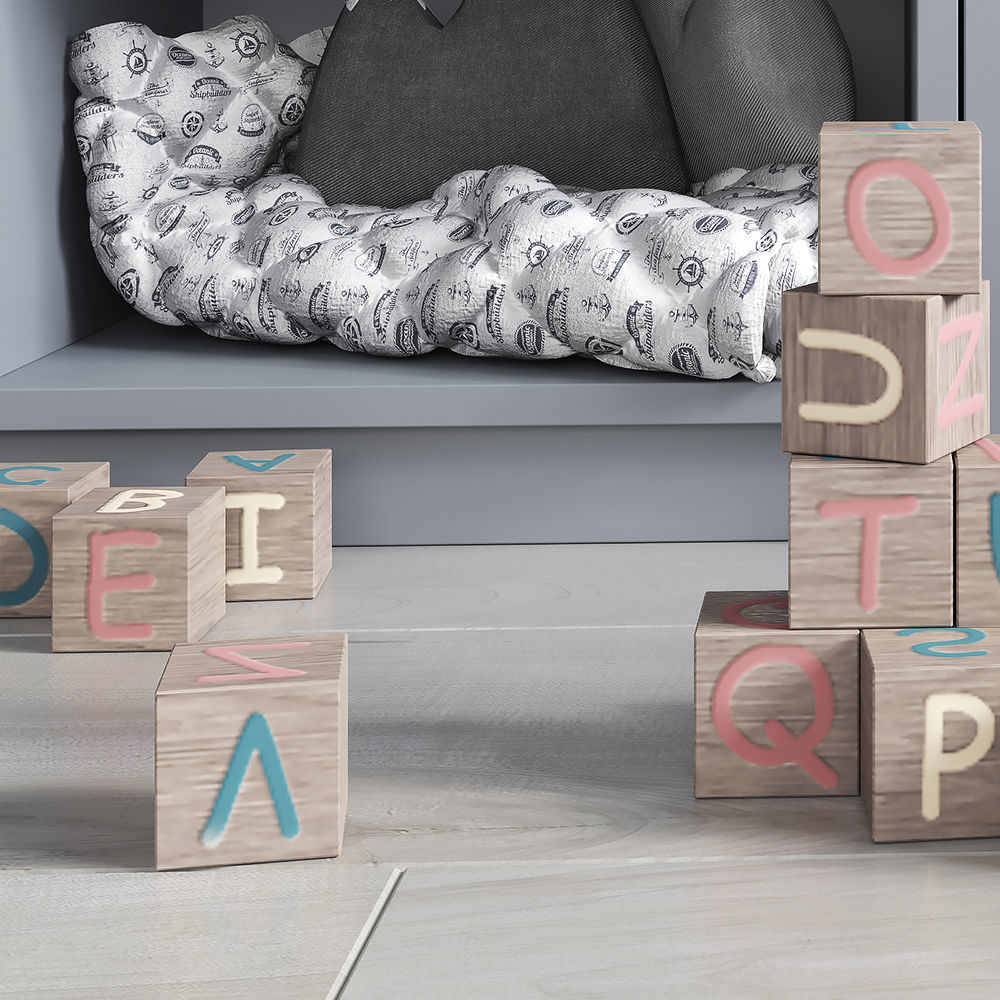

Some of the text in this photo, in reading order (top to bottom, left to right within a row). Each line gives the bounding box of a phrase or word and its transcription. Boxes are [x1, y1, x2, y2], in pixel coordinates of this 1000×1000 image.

[846, 157, 951, 277] O
[938, 313, 983, 428] Z
[95, 488, 184, 513] B
[226, 492, 286, 585] I
[818, 496, 919, 611] T
[86, 529, 160, 639] E
[711, 643, 839, 789] Q
[922, 693, 996, 821] P
